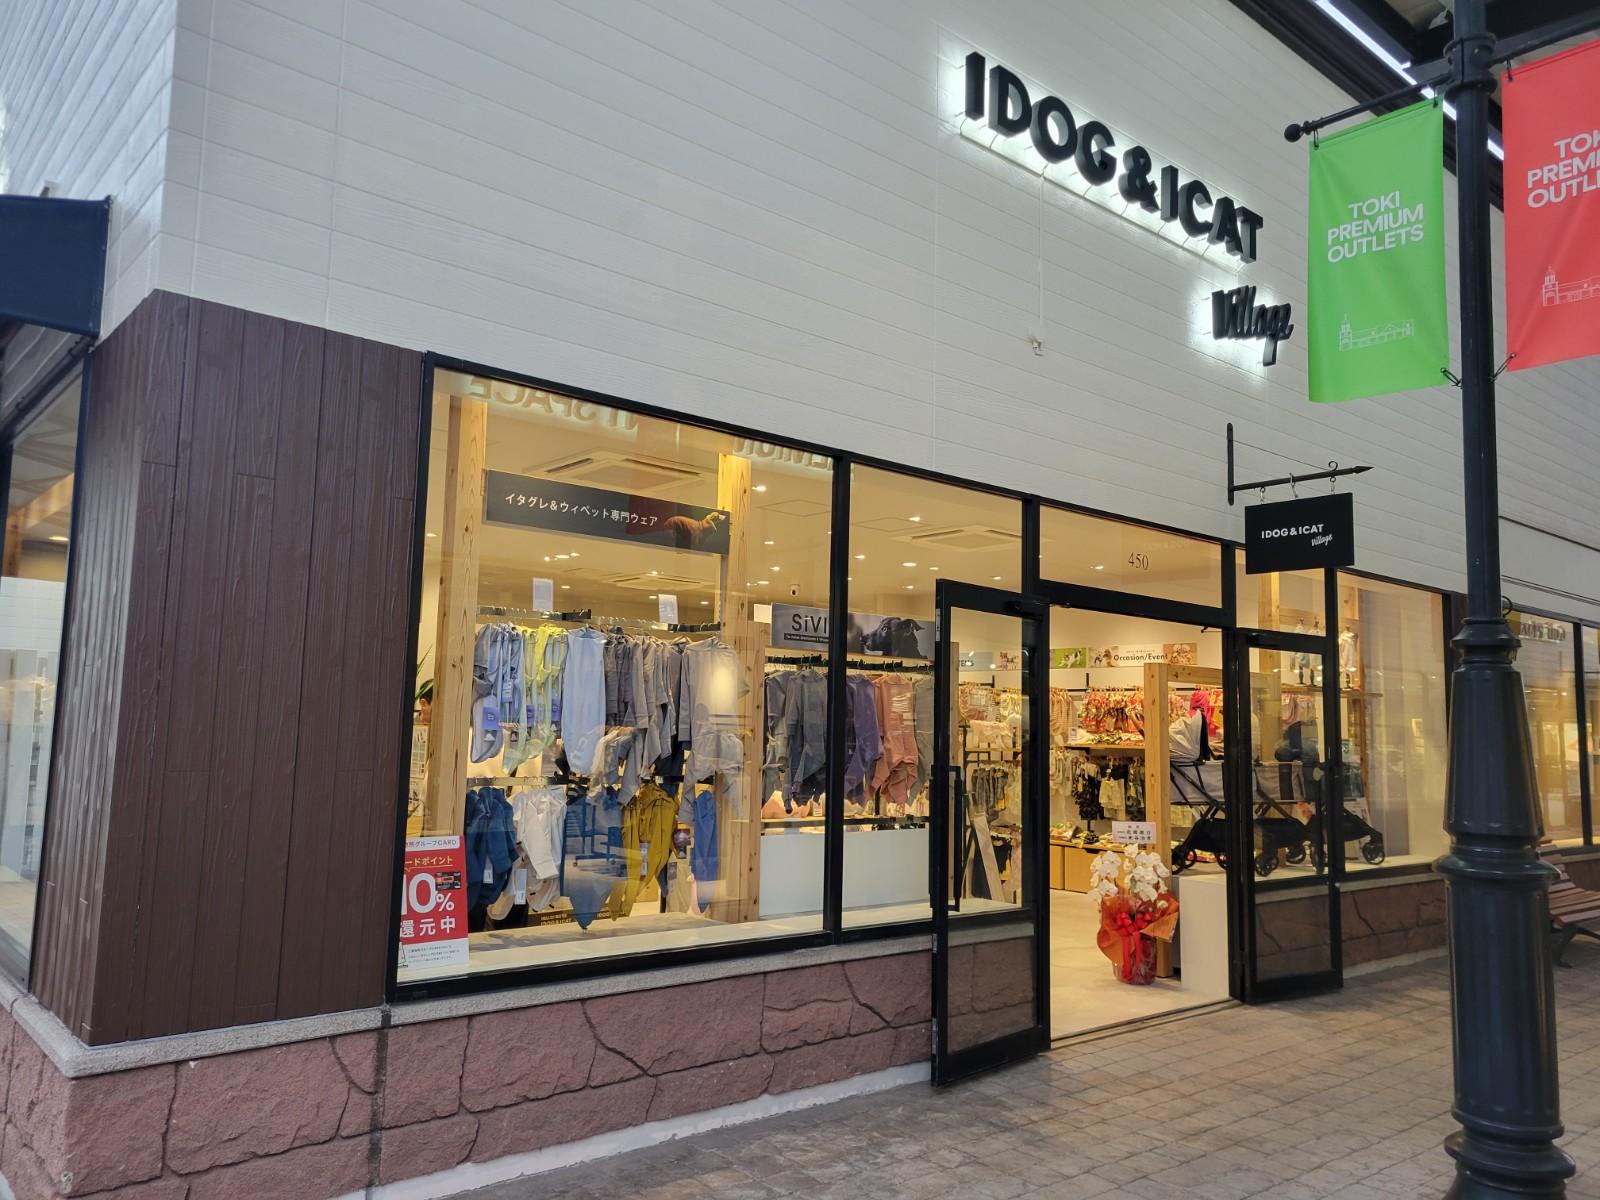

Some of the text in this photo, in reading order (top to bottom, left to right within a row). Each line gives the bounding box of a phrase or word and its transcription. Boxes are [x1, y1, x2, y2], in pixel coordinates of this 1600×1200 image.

[1348, 191, 1400, 218] TOKI
[1527, 170, 1600, 208] OUTL
[1328, 203, 1423, 245] PREMIUM
[1328, 222, 1424, 263] OUTLETS
[1128, 552, 1149, 571] 450
